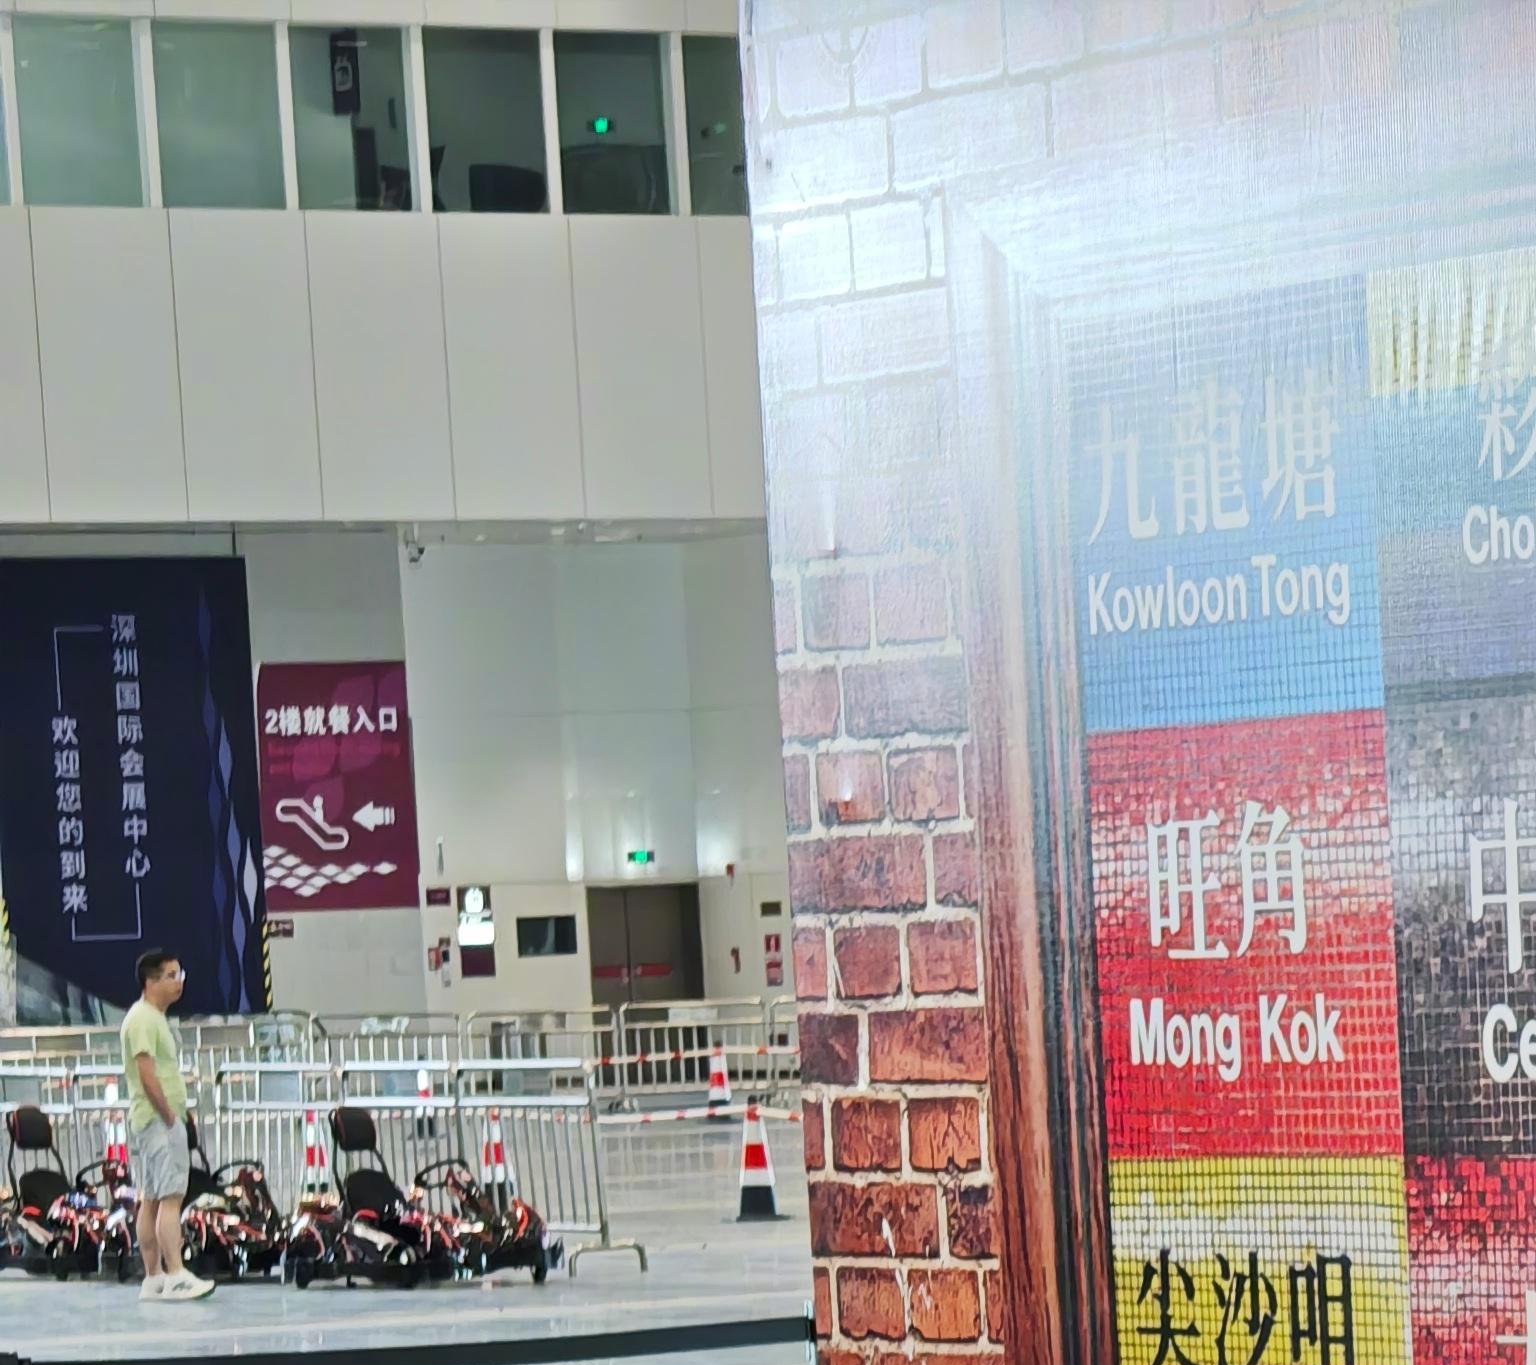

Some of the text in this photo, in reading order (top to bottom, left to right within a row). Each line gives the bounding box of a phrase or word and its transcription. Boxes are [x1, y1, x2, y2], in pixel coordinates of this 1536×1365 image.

[1084, 366, 1342, 545] 九龍塘
[1088, 554, 1350, 635] Kowloon Tong
[51, 715, 88, 915] 欢迎您的到来
[109, 613, 151, 879] 深圳国际会展中心
[1146, 800, 1308, 960] 旺角
[1129, 993, 1345, 1081] Mong Kok
